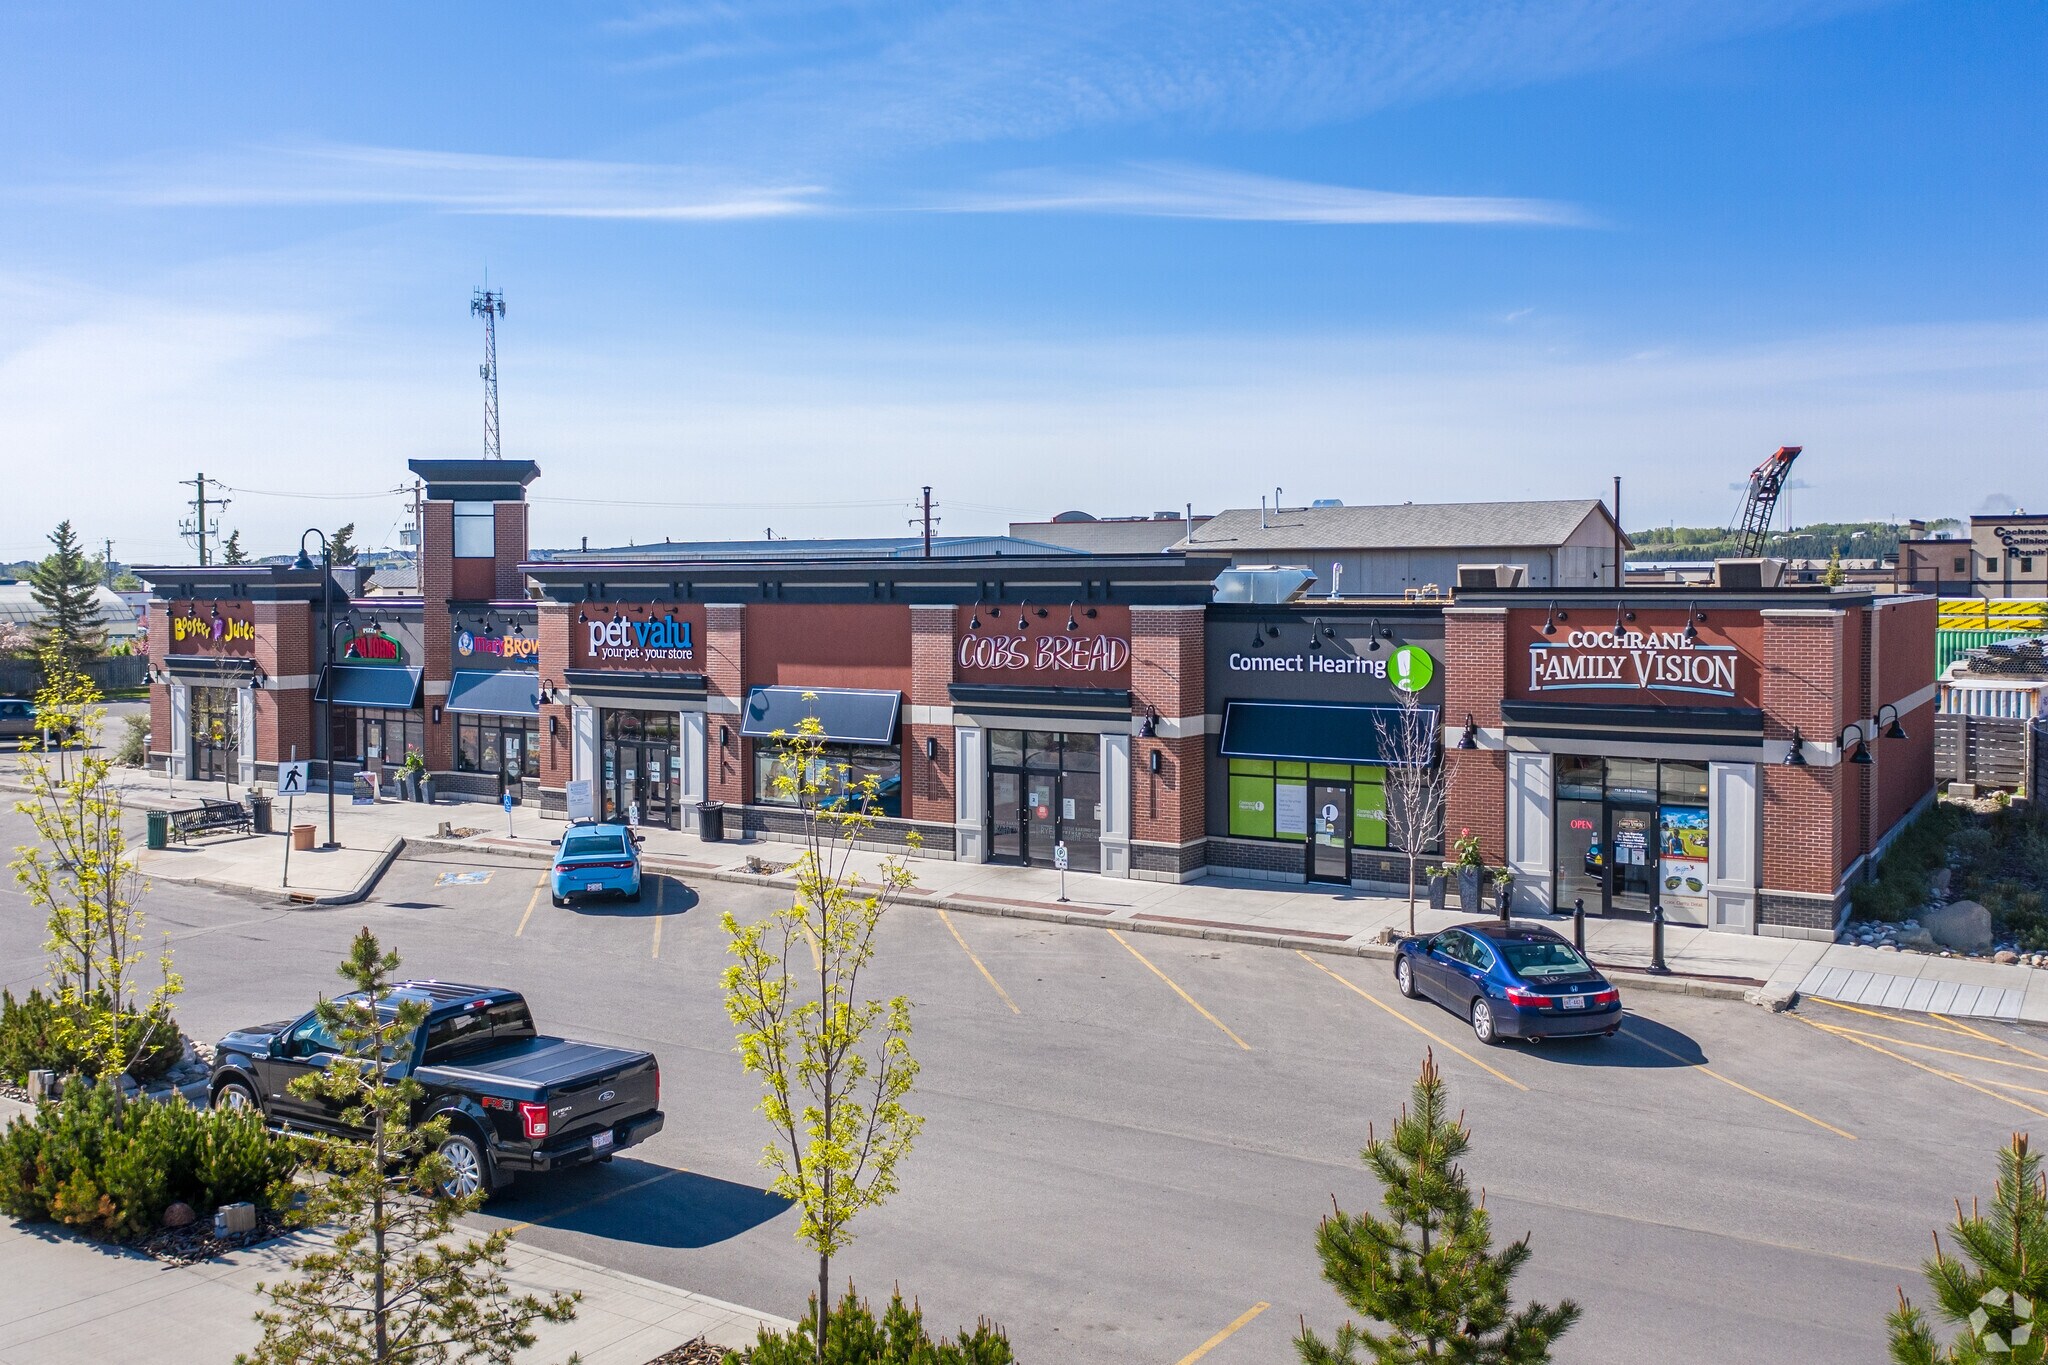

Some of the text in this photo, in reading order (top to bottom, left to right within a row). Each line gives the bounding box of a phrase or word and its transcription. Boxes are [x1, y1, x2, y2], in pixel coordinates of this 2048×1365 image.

[1994, 527, 2047, 537] Cochrane
[2008, 547, 2046, 558] Repair
[174, 616, 255, 642] Booster Juice
[588, 614, 692, 657] pet valu
[1568, 631, 1694, 650] COCHRANE
[602, 647, 693, 661] your pet your store
[958, 634, 1131, 672] COBS BREAD
[1229, 653, 1387, 679] Connect Hearing
[1528, 648, 1738, 691] FAMILY VISION
[1570, 819, 1593, 829] OPEN
